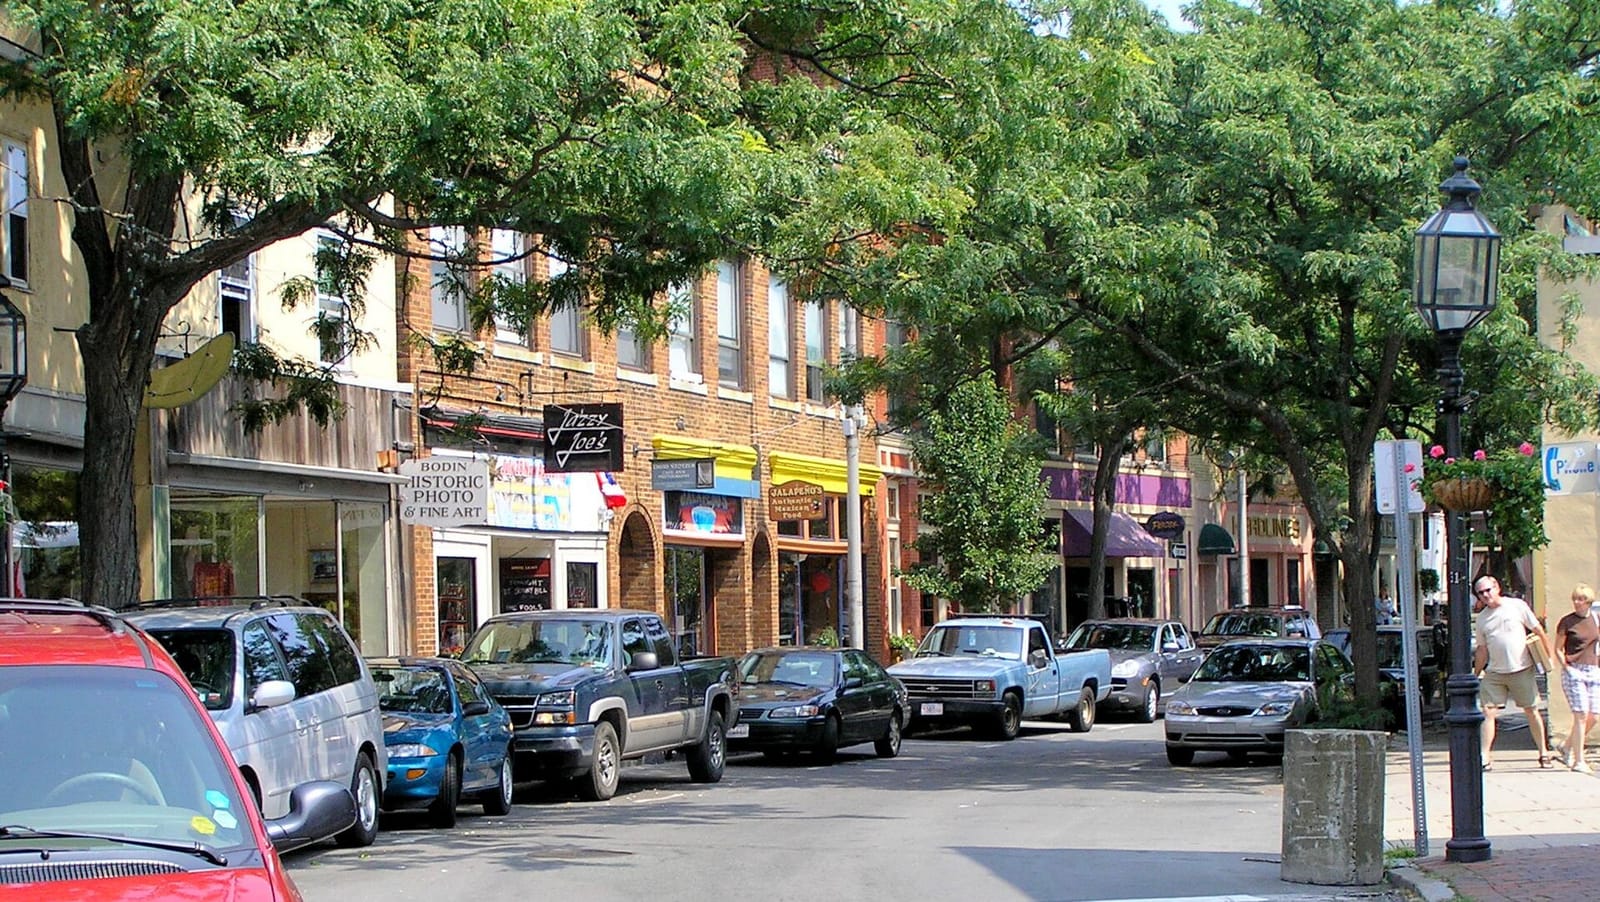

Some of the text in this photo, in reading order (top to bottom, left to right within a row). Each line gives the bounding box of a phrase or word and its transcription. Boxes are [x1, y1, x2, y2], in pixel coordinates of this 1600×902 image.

[556, 431, 611, 468] Joe's
[421, 462, 467, 472] BODIN
[404, 475, 484, 488] HISTORIC
[414, 490, 474, 503] PHOTO
[772, 497, 812, 505] Authentic
[404, 506, 482, 518] & FINE ART
[1232, 516, 1300, 539] HRDLINES
